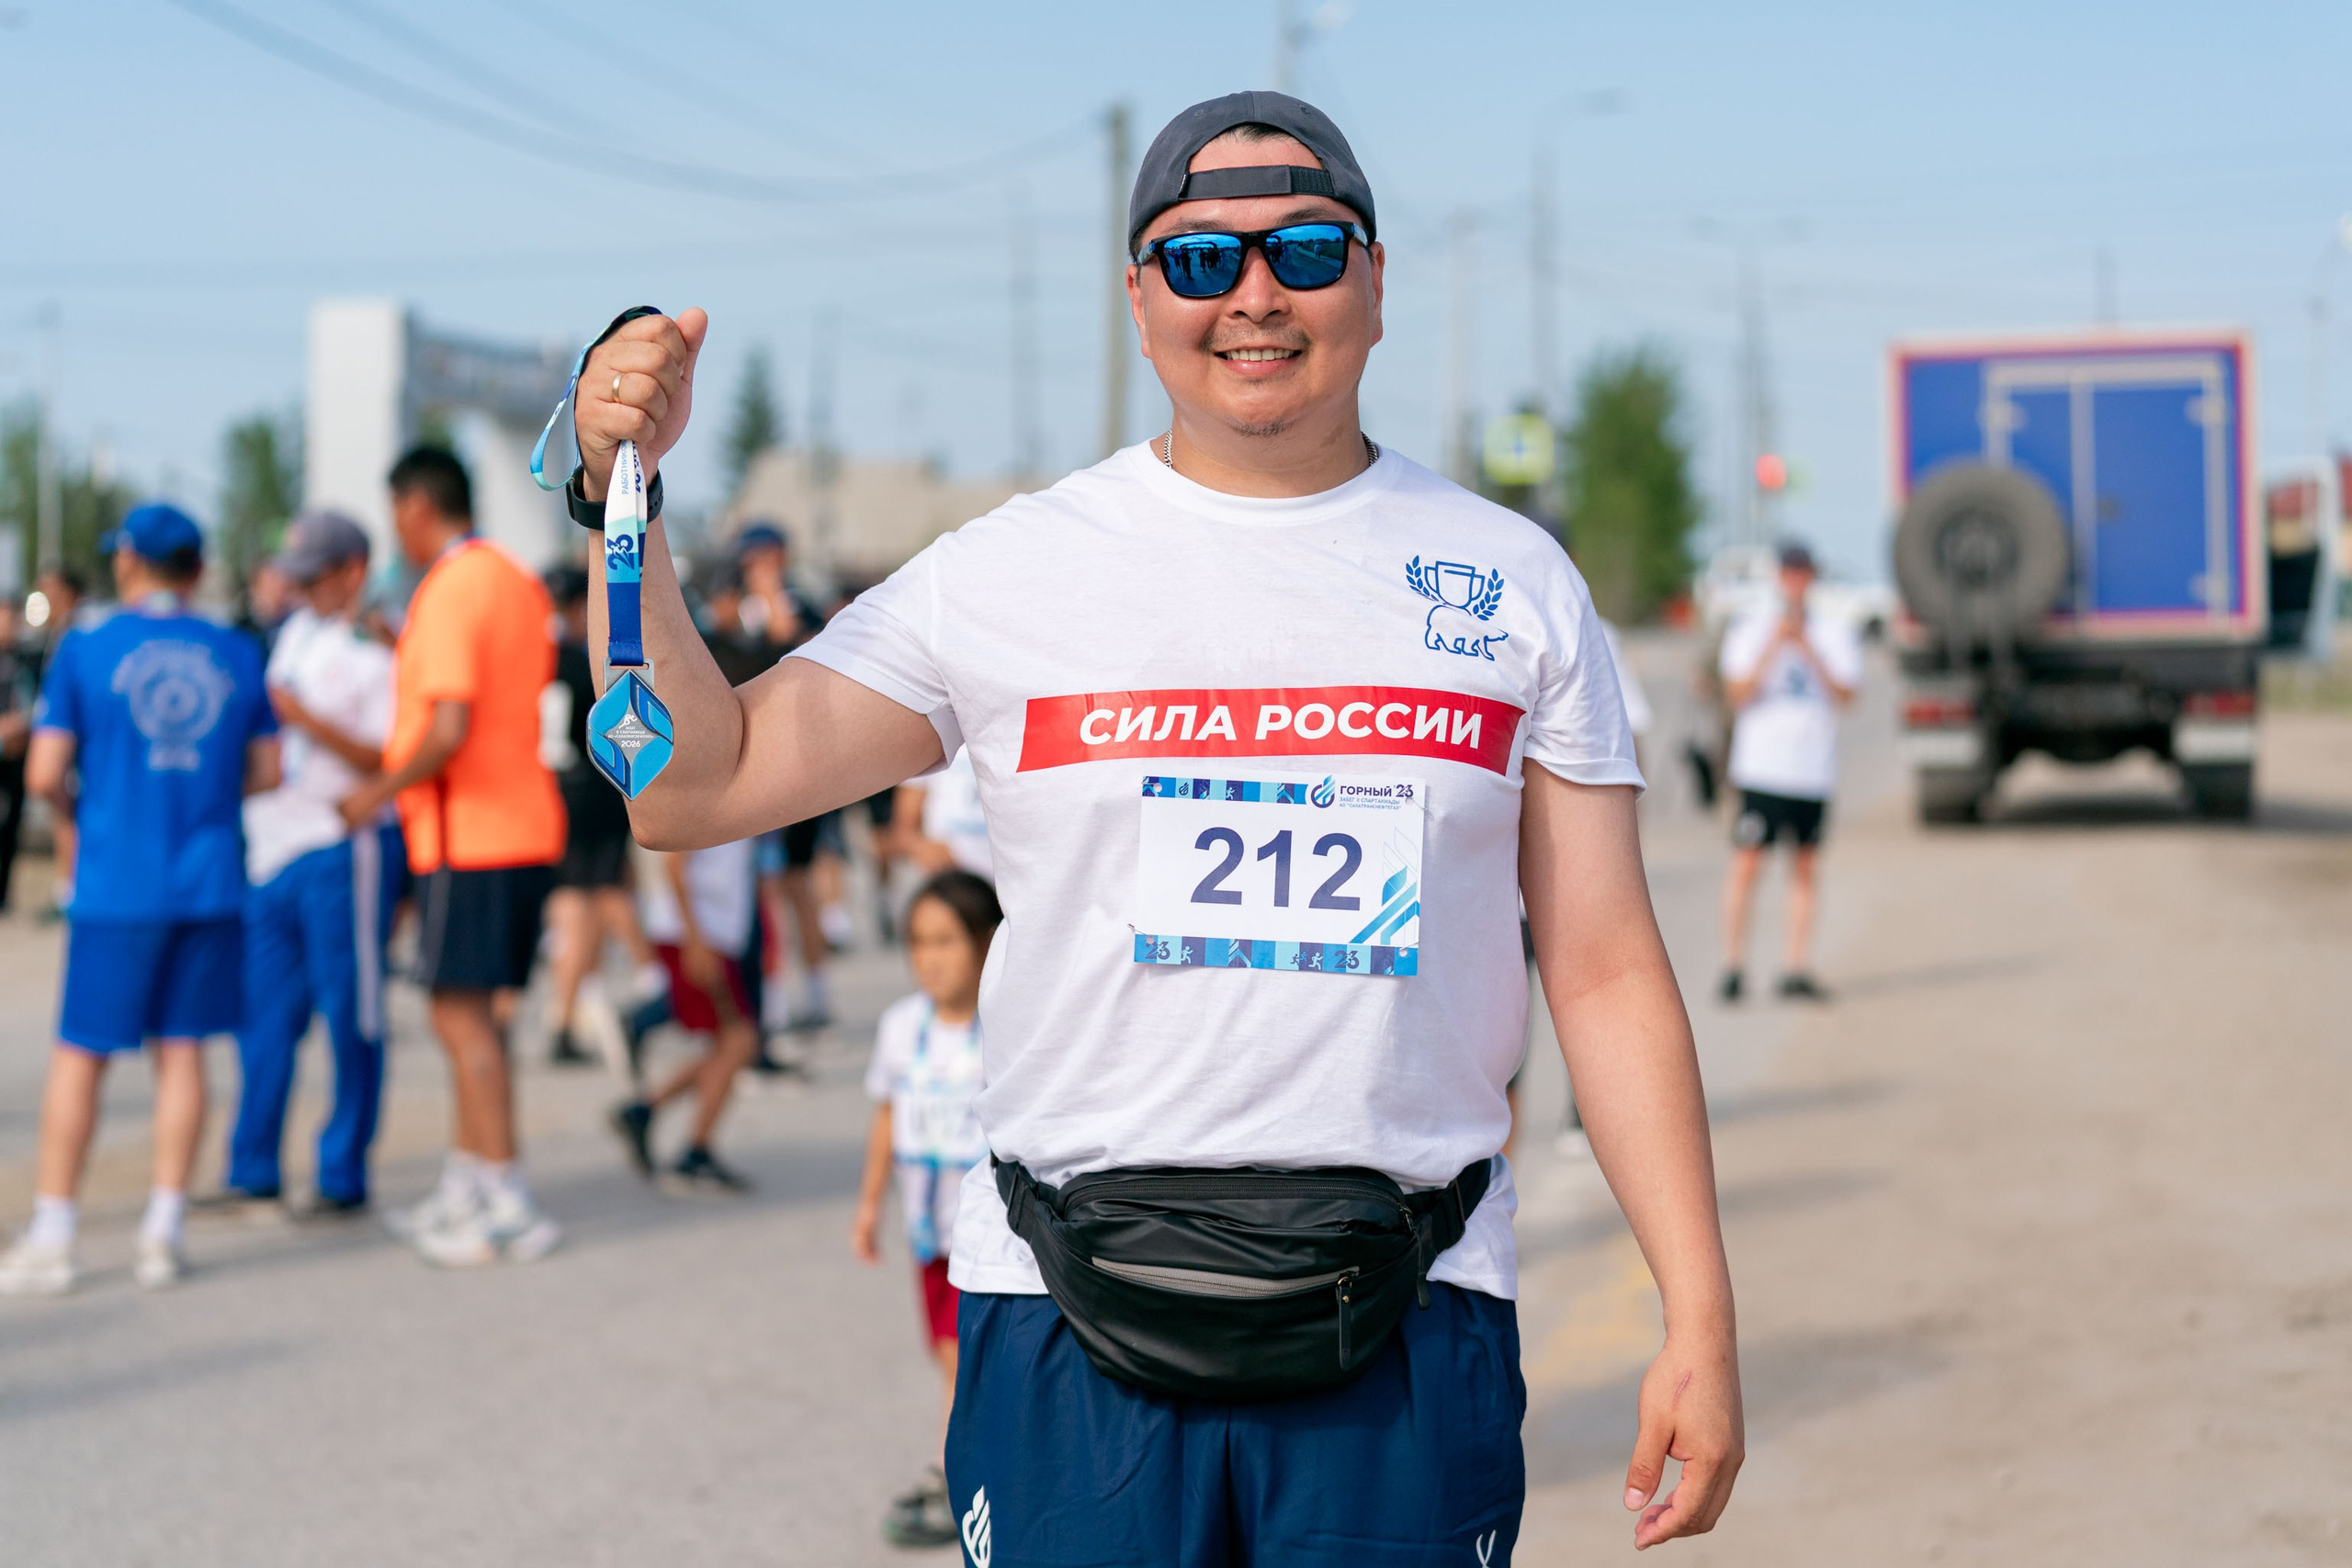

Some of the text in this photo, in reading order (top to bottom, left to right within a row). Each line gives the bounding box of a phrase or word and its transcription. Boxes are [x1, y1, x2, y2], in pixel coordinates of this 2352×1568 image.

[1080, 701, 1482, 750] СИЛА РОССИИ
[1340, 786, 1392, 796] ГОРНЫЙ
[1190, 827, 1363, 911] 212
